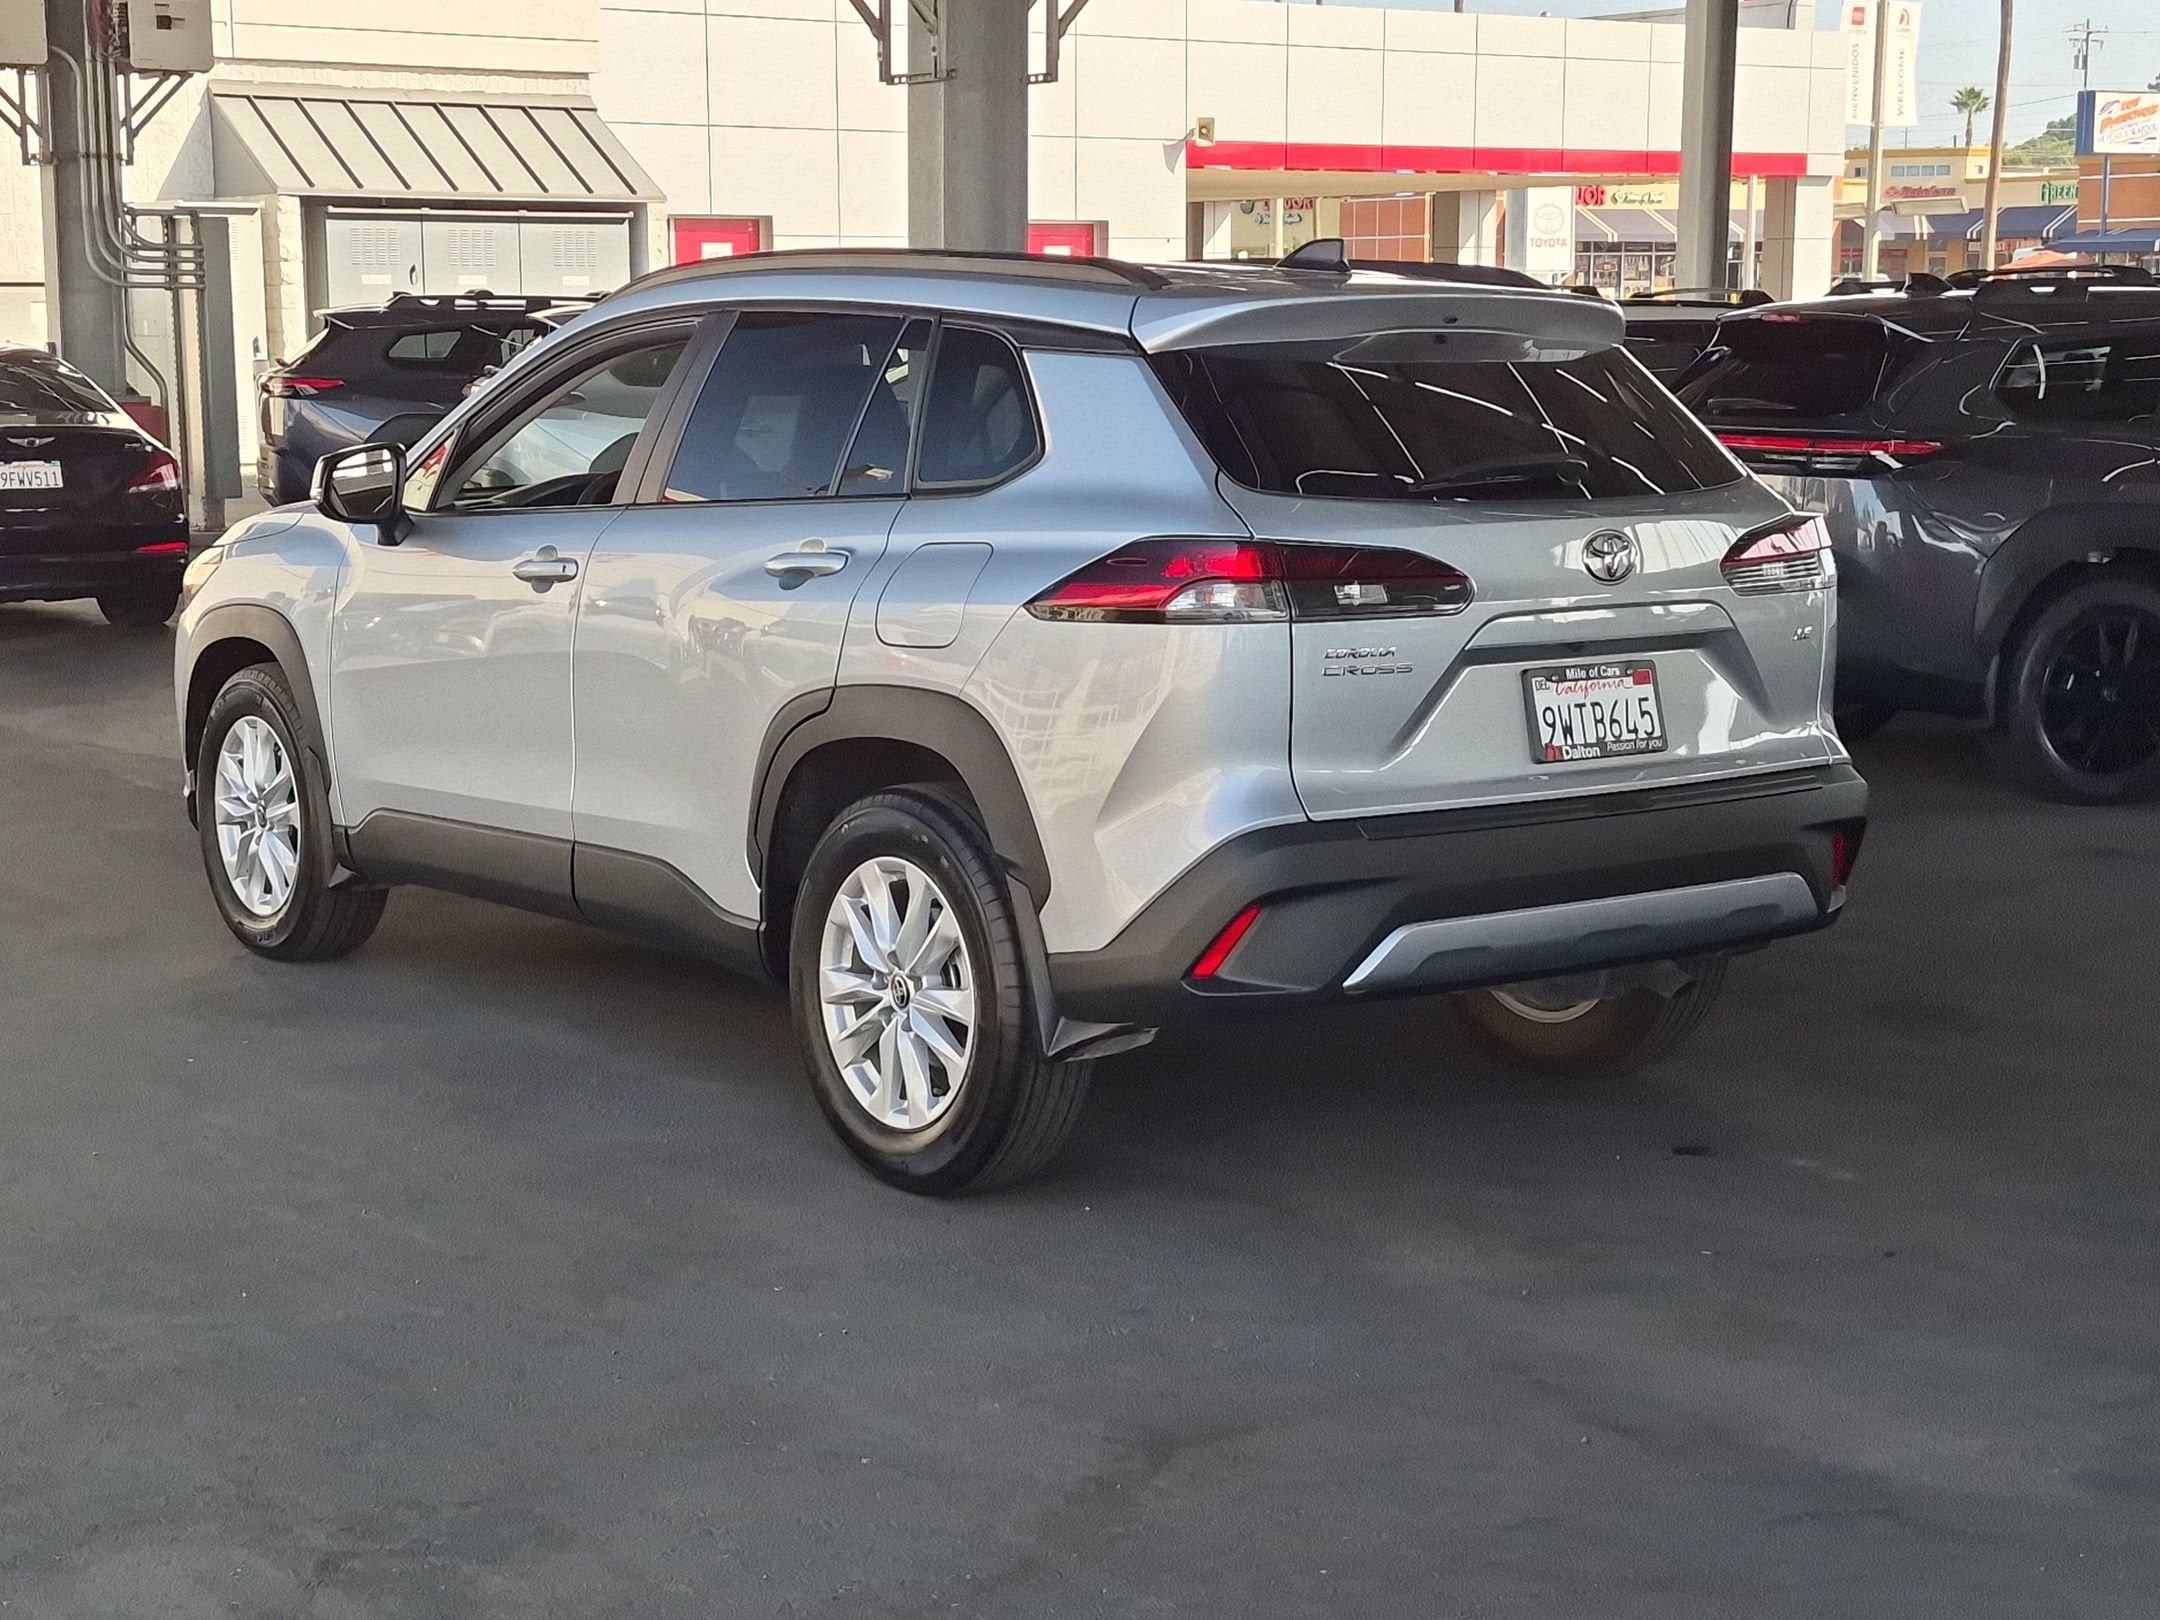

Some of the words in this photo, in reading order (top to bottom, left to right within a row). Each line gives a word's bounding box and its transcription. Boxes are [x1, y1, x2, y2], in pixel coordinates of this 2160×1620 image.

[1529, 237, 1568, 248] TOYOTA
[0, 471, 61, 488] 9FWV511
[1324, 646, 1397, 660] COROLLA
[1322, 662, 1414, 676] CROSS
[1566, 668, 1587, 681] Mile
[1588, 666, 1599, 678] of
[1600, 665, 1621, 677] Cars
[1555, 679, 1633, 699] California
[1542, 697, 1656, 745] 9WTB645
[1563, 745, 1601, 760] Dalton
[1606, 740, 1635, 752] Passion
[1636, 738, 1647, 749] for
[1648, 738, 1663, 750] you
